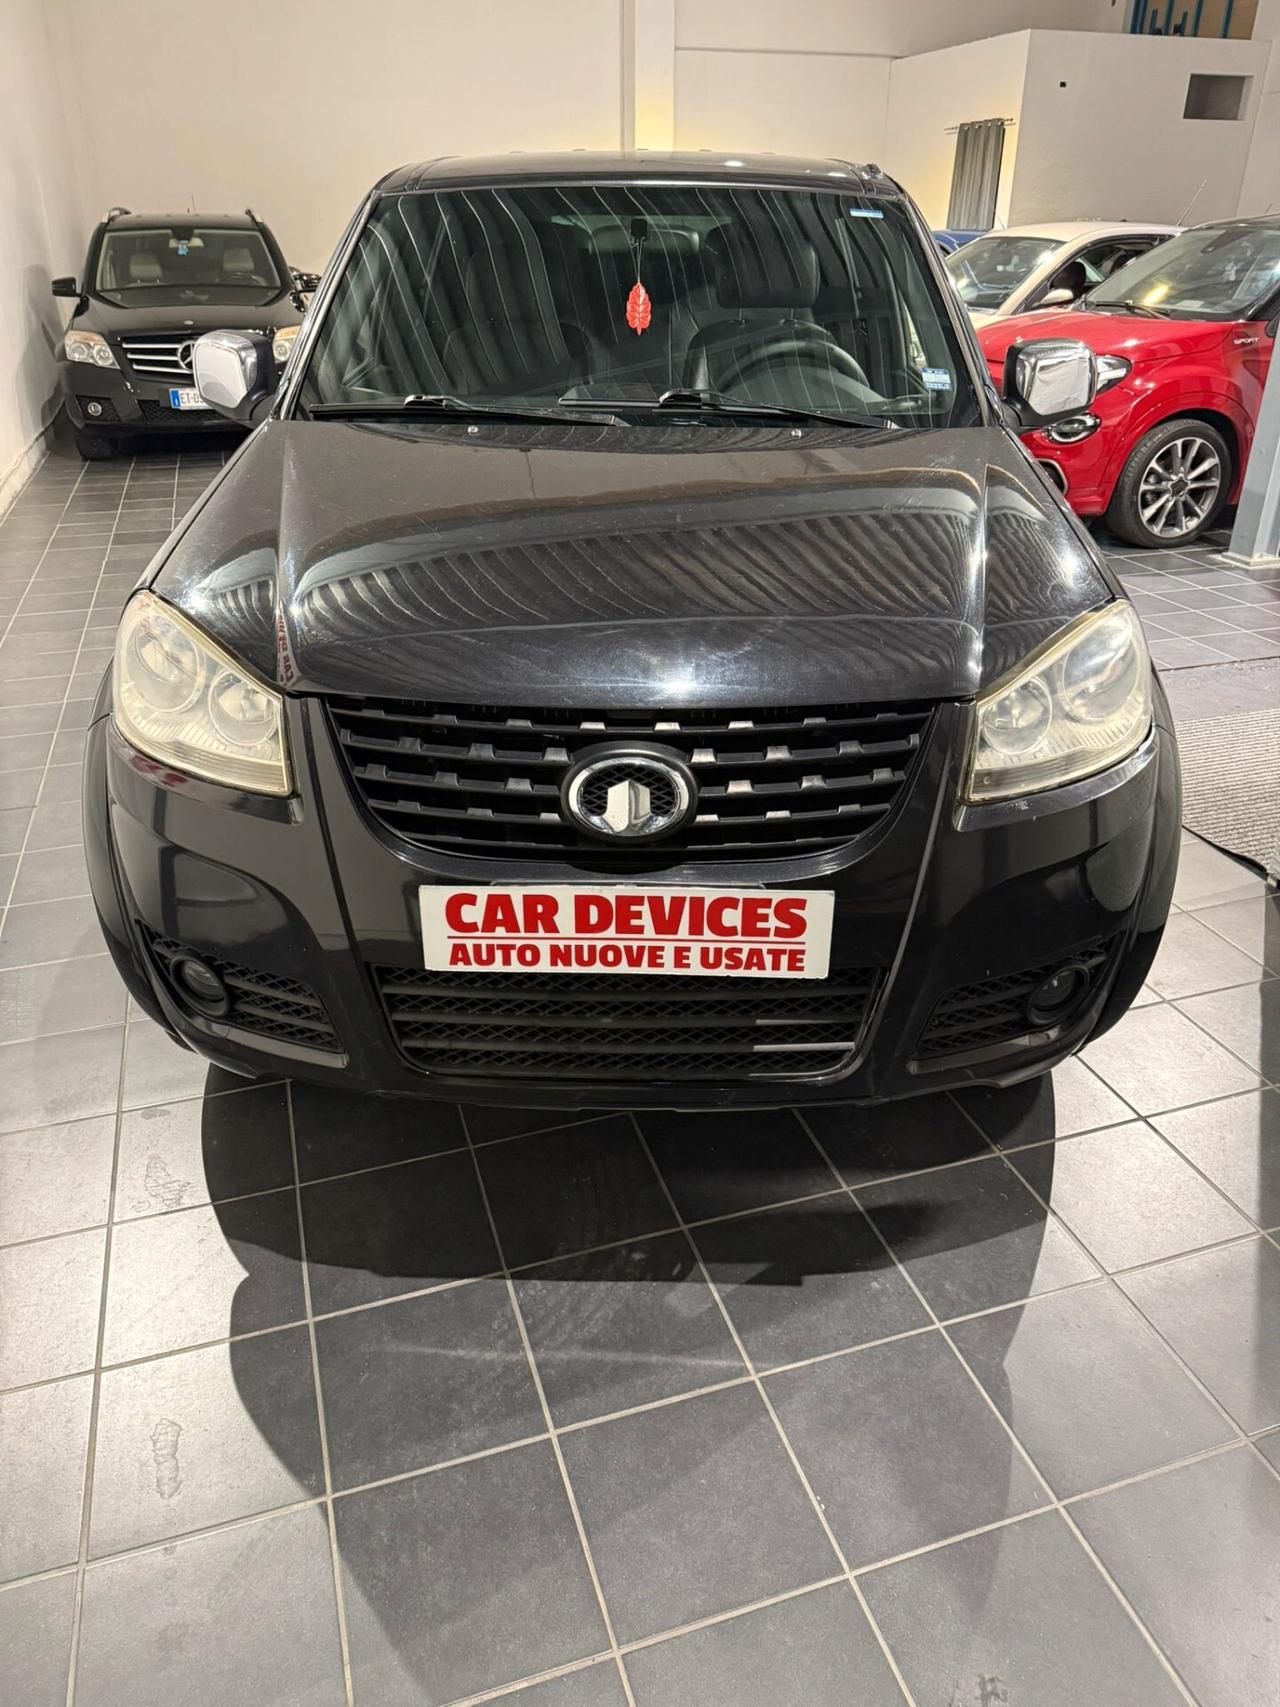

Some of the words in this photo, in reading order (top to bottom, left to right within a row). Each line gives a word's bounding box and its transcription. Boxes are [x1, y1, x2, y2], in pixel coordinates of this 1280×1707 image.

[444, 892, 560, 935] CAR
[573, 894, 808, 939] DEVICES
[449, 943, 541, 968] AUTO
[549, 943, 665, 969] NUOVE
[672, 945, 691, 969] E
[699, 946, 806, 972] USATE
